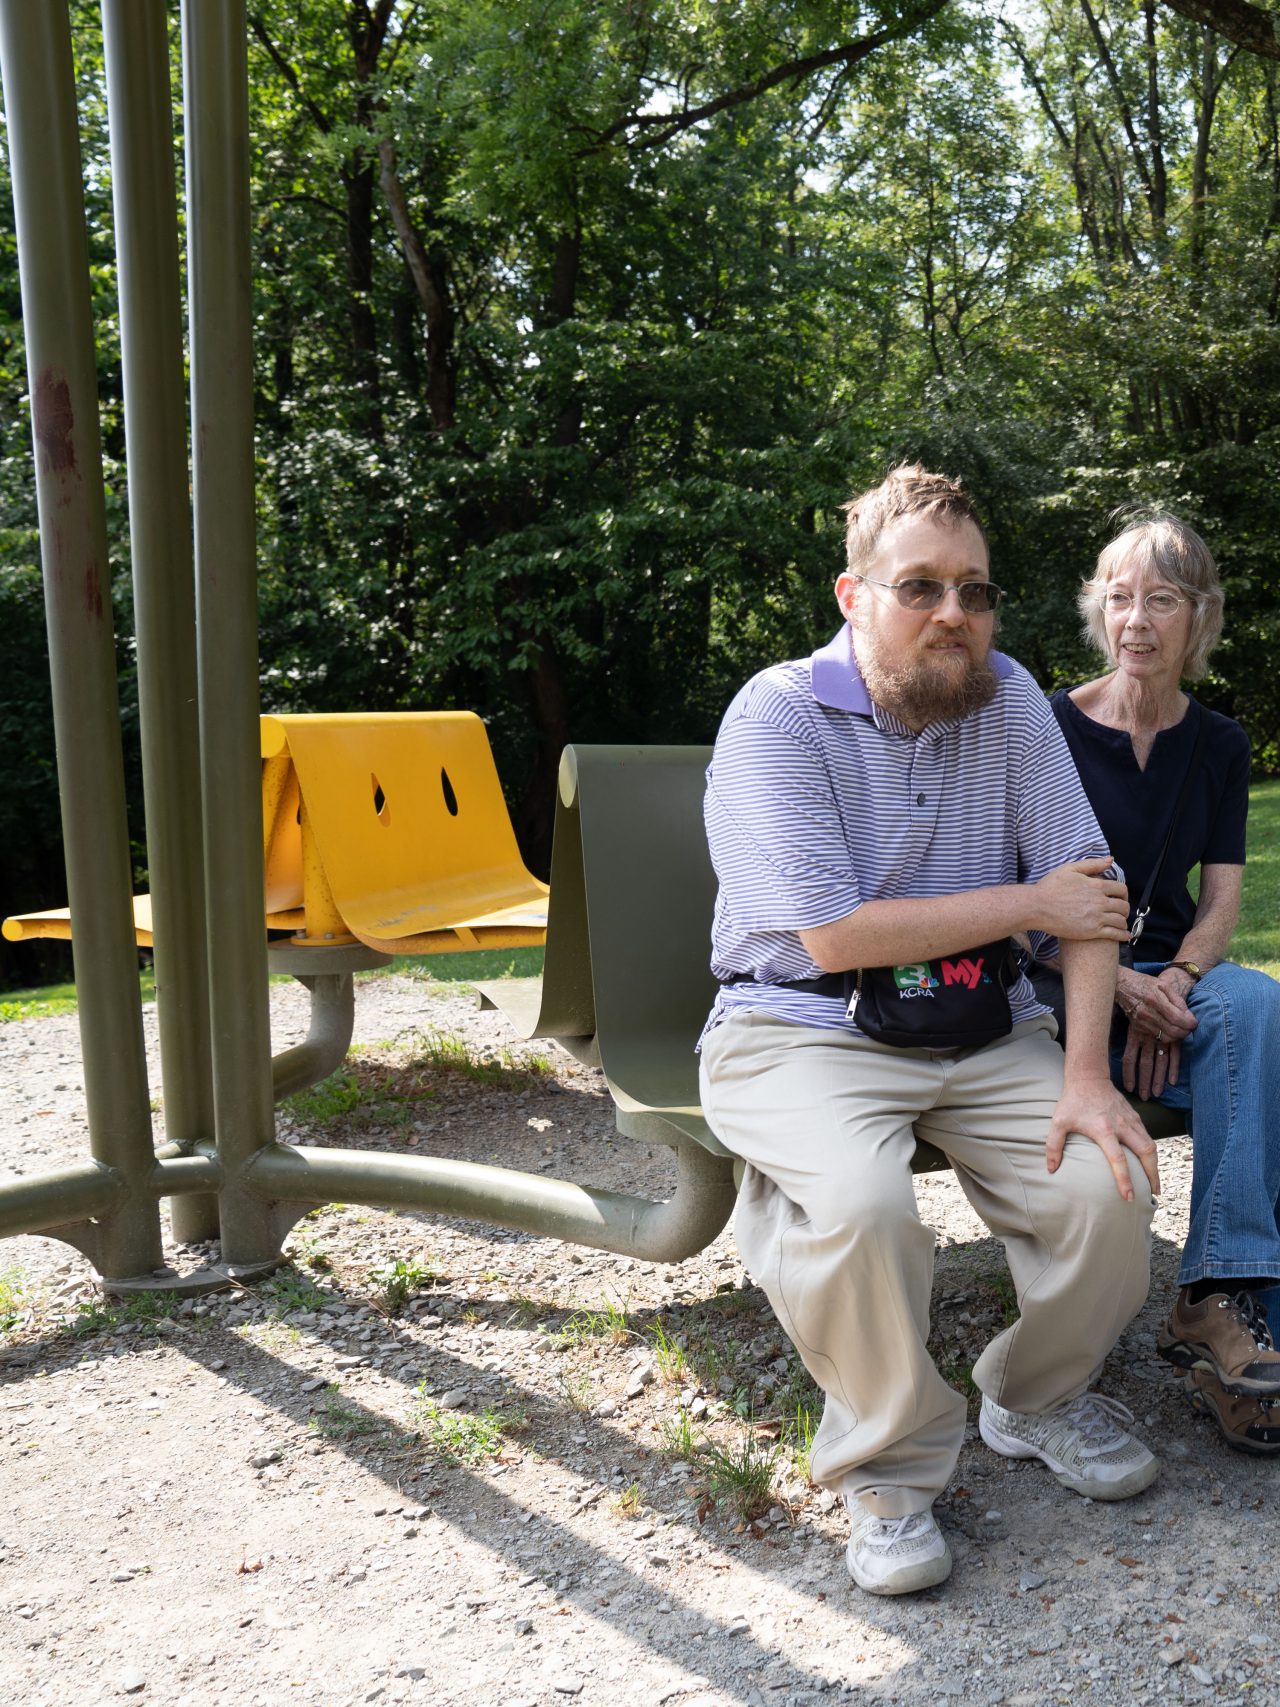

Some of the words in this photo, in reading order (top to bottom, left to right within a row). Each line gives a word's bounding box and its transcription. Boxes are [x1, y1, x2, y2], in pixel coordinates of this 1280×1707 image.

[897, 964, 926, 985] 3
[941, 958, 984, 989] MY
[899, 987, 935, 999] KCRA
